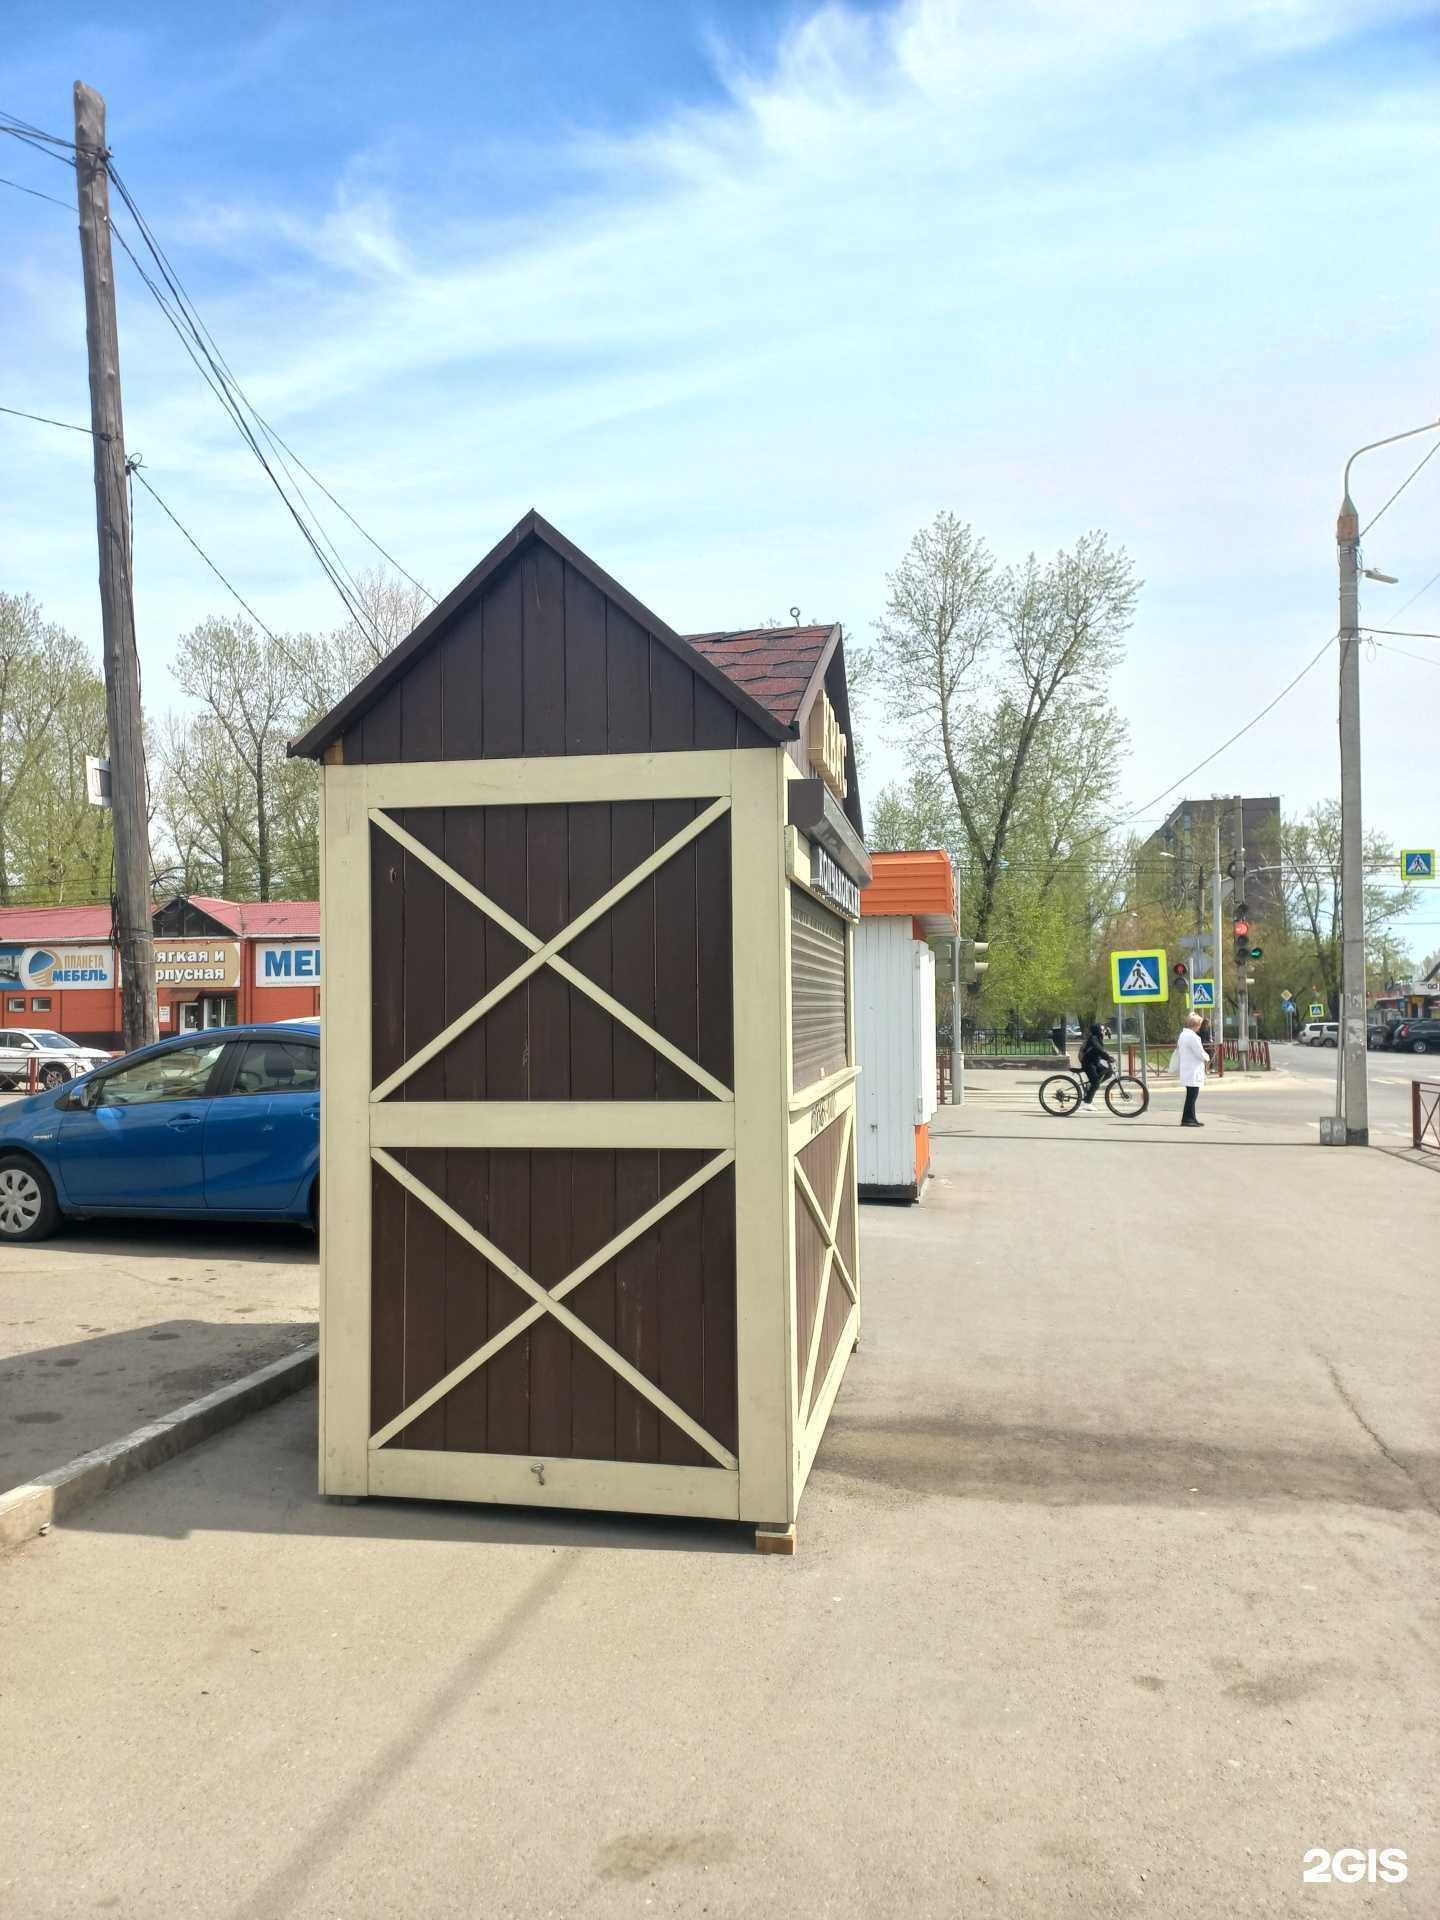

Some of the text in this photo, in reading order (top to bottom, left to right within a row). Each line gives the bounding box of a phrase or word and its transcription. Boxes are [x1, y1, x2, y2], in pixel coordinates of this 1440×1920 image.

[64, 954, 105, 969] ПЛАНЕТА
[154, 950, 225, 963] ягкая и
[265, 950, 320, 977] МЕ
[52, 969, 108, 982] МЕБЕЛЬ
